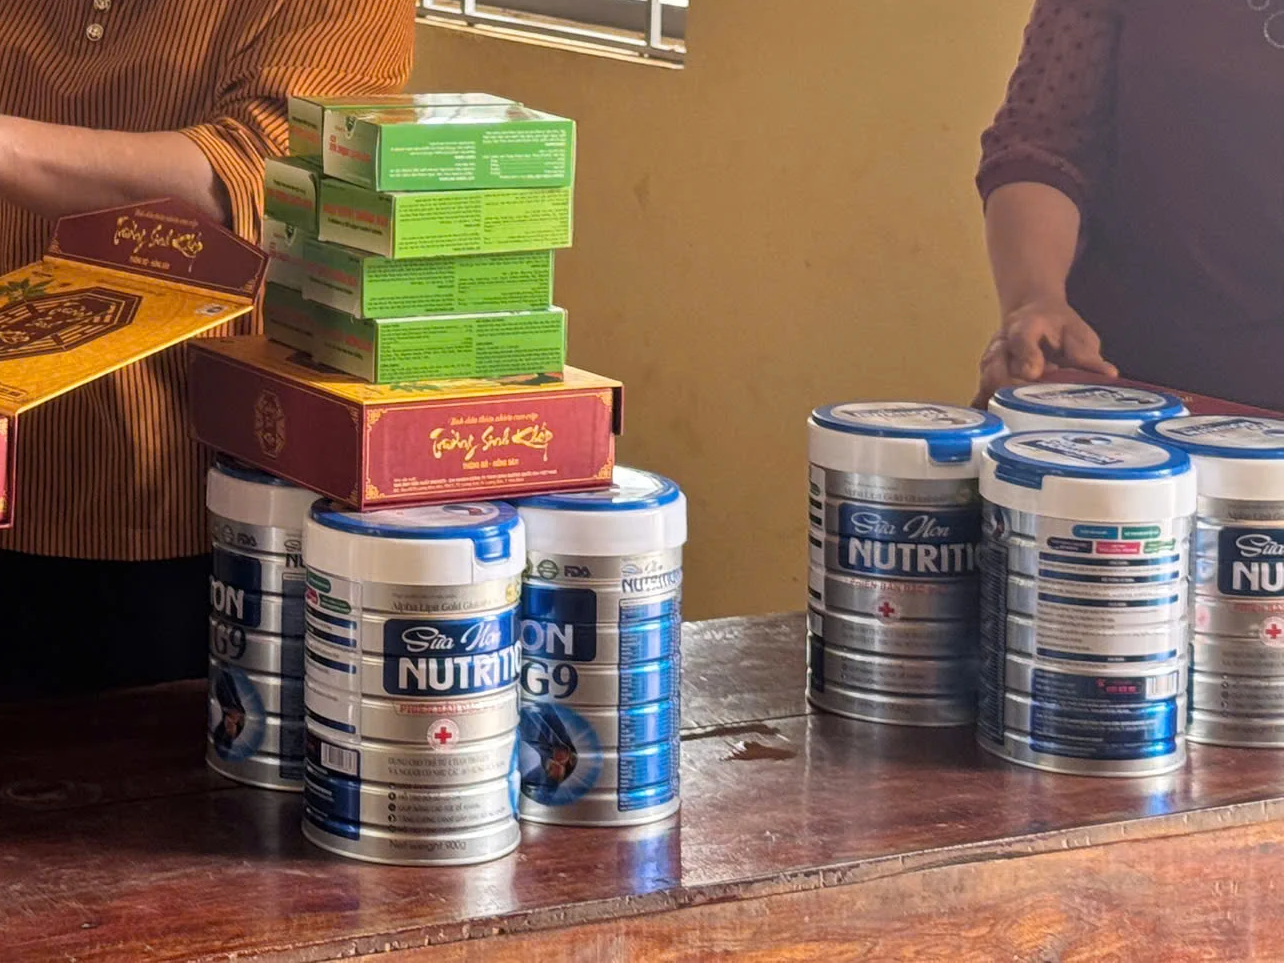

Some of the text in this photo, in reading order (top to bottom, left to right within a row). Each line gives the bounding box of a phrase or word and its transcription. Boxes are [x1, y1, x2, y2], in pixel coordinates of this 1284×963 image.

[903, 515, 950, 539] Non
[564, 565, 592, 578] FDA
[520, 659, 578, 699] G9
